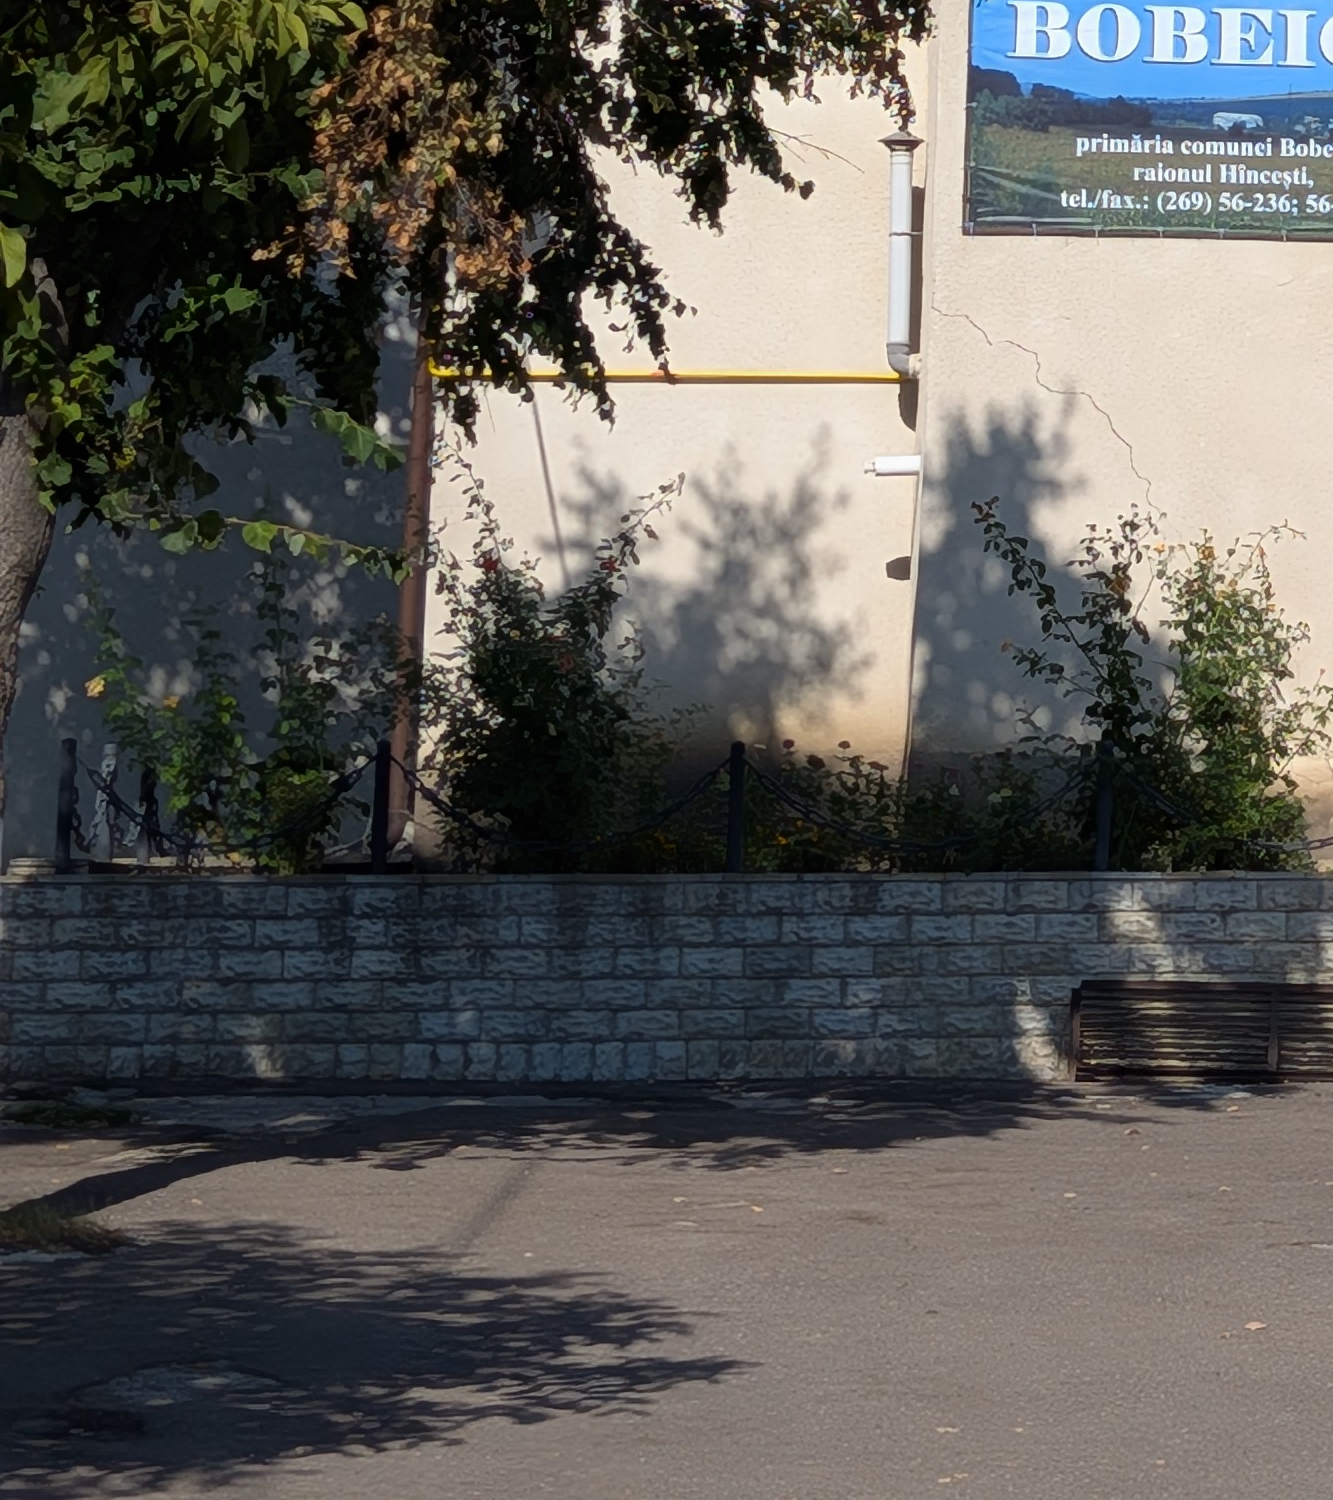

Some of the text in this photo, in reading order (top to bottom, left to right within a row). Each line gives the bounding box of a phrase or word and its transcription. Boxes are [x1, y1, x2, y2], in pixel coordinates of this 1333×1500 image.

[1076, 133, 1174, 157] primăria
[1181, 137, 1273, 157] comunei
[1133, 163, 1212, 183] raionul
[1157, 191, 1212, 215] (269)
[1218, 194, 1298, 216] 56-236;
